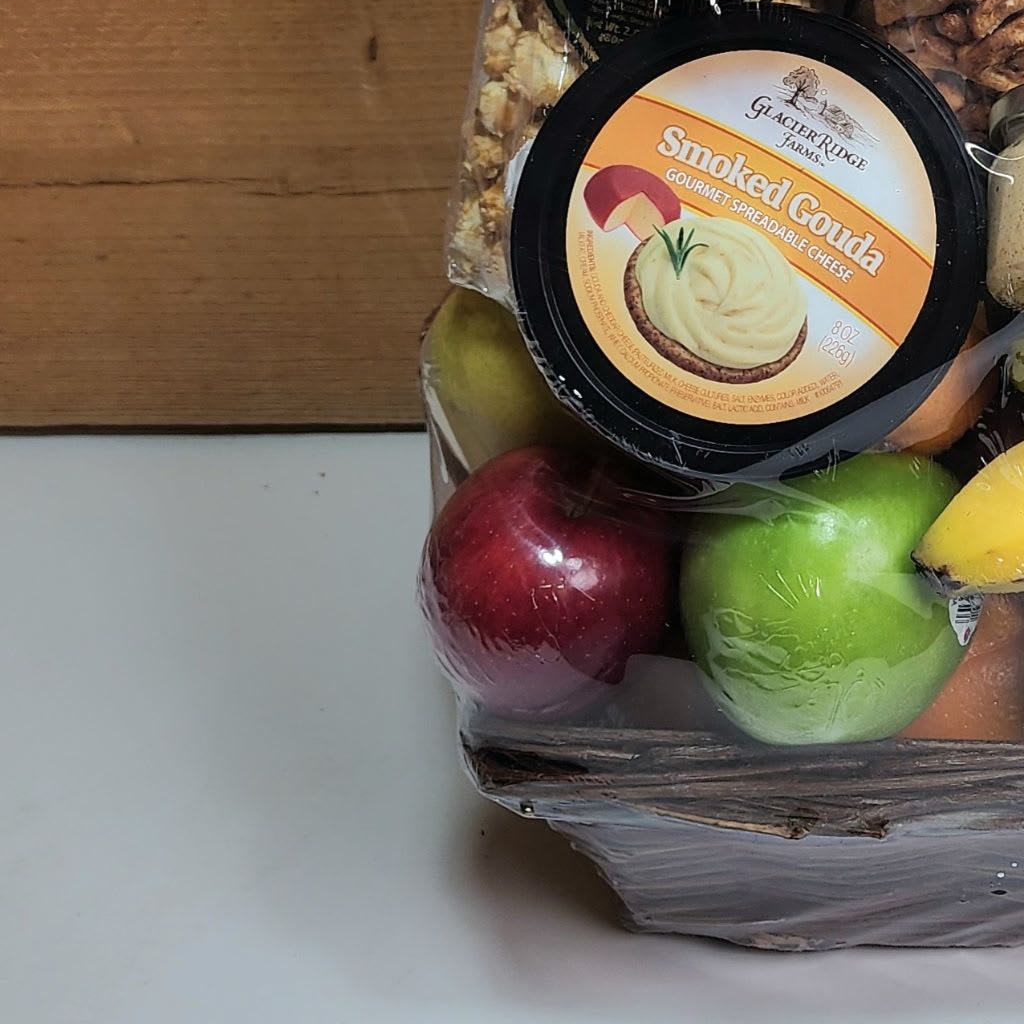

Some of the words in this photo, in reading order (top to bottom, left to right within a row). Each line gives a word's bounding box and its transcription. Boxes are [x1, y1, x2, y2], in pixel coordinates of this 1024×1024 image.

[775, 131, 821, 164] FARMS
[656, 125, 792, 211] Smoked
[787, 191, 885, 278] Gouda
[665, 168, 731, 206] GOURMET
[729, 198, 809, 253] SPREADABLE
[806, 245, 854, 284] CHEESE
[830, 320, 843, 335] 8
[841, 325, 861, 345] OZ
[817, 335, 857, 368] (226g)
